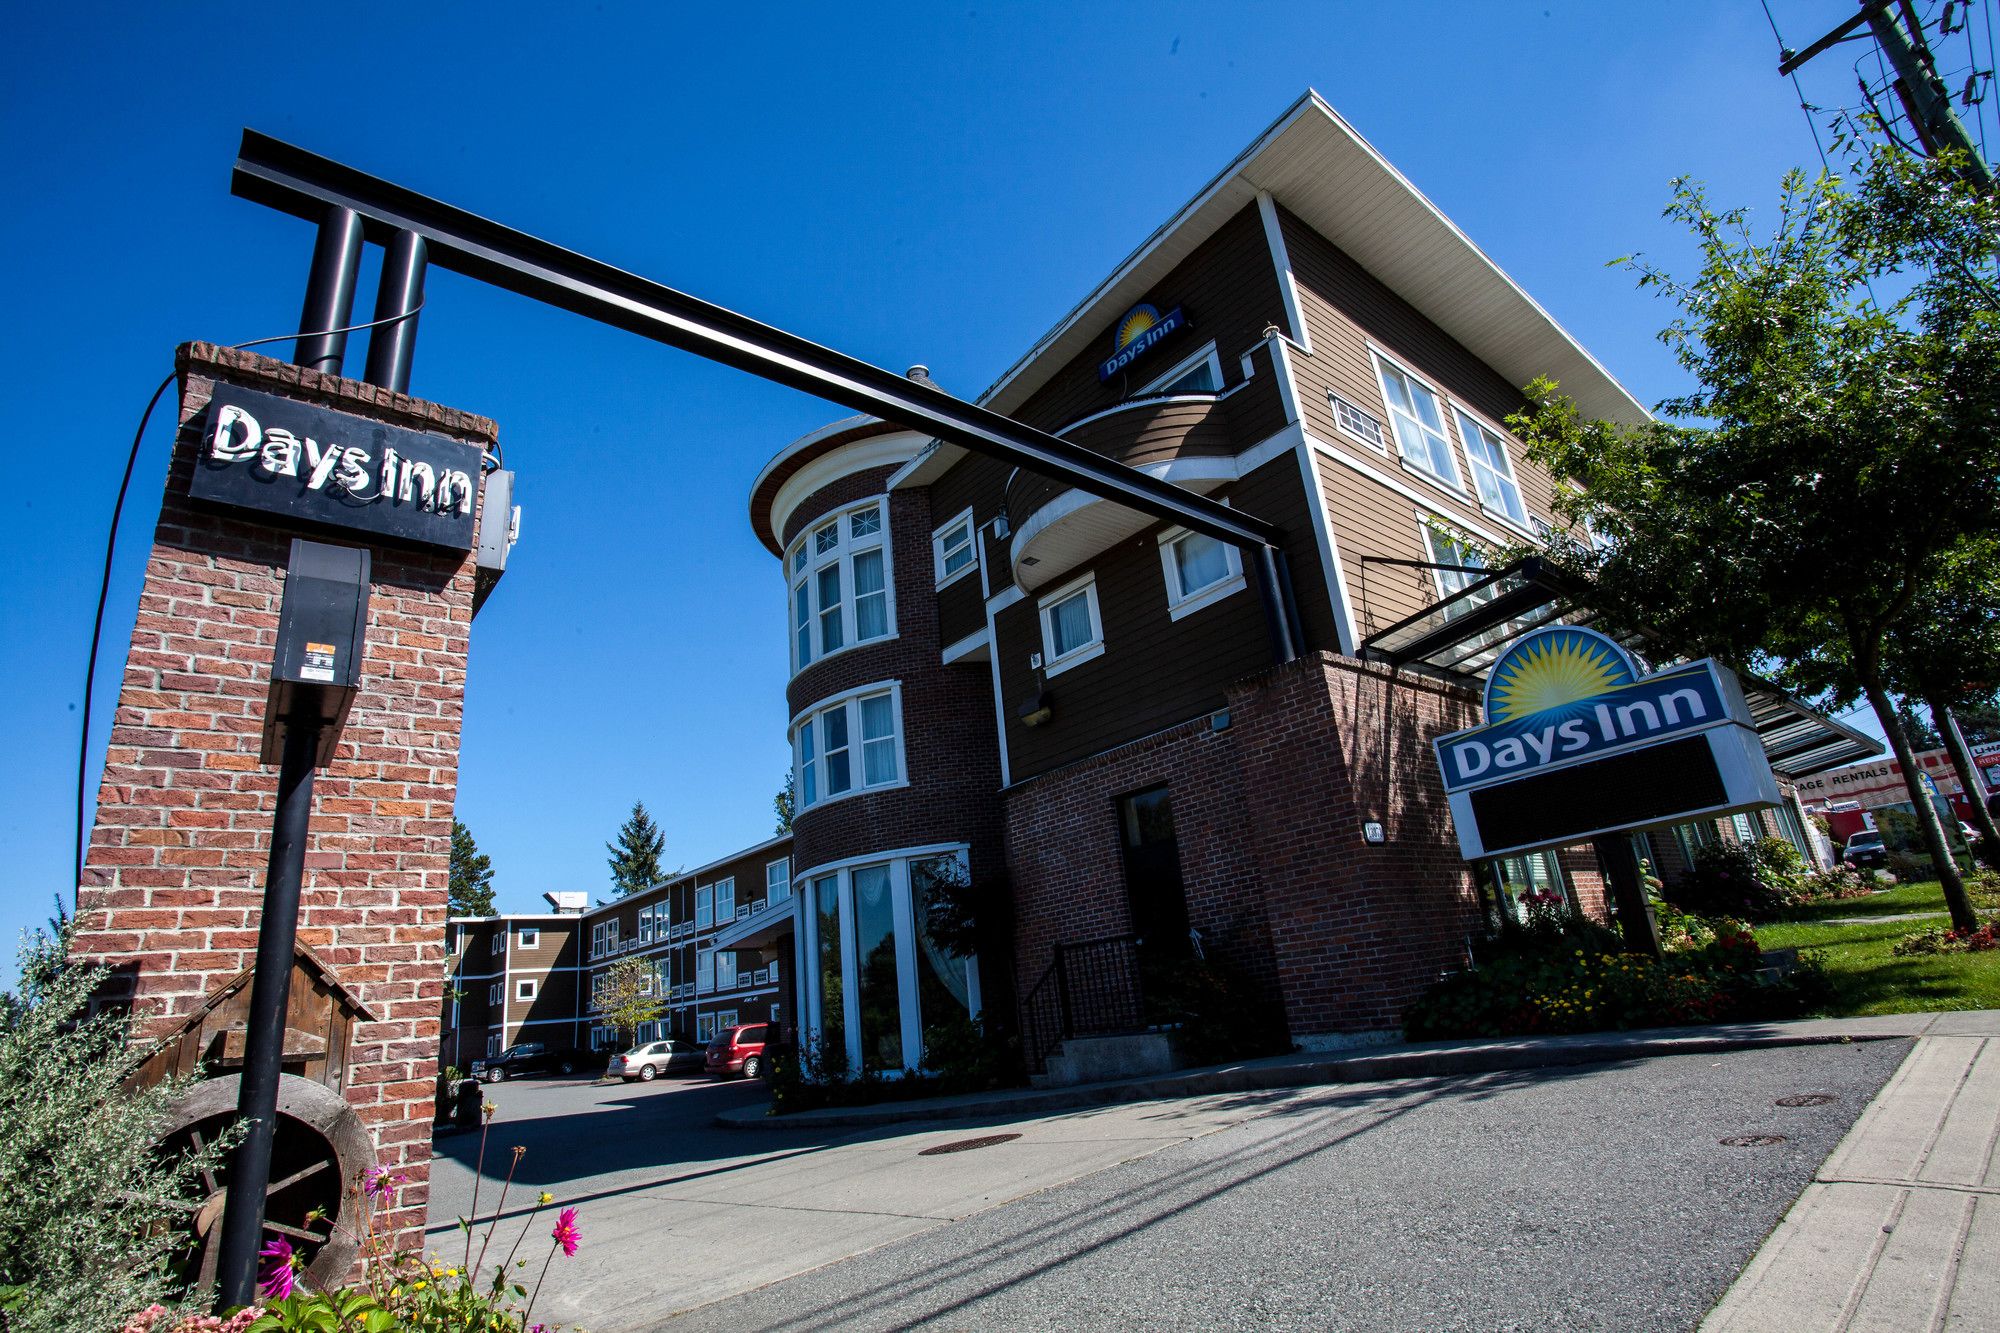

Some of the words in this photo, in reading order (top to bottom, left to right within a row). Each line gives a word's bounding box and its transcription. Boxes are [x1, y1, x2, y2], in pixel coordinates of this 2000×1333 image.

[1106, 340, 1146, 375] Days
[1146, 319, 1175, 346] Inn
[212, 404, 371, 490] Days
[380, 447, 473, 516] Inn
[1452, 718, 1590, 779] Days
[1594, 687, 1707, 742] Inn
[1979, 755, 2000, 765] REN
[1795, 780, 1823, 792] AGE
[1832, 767, 1888, 784] RENTALS
